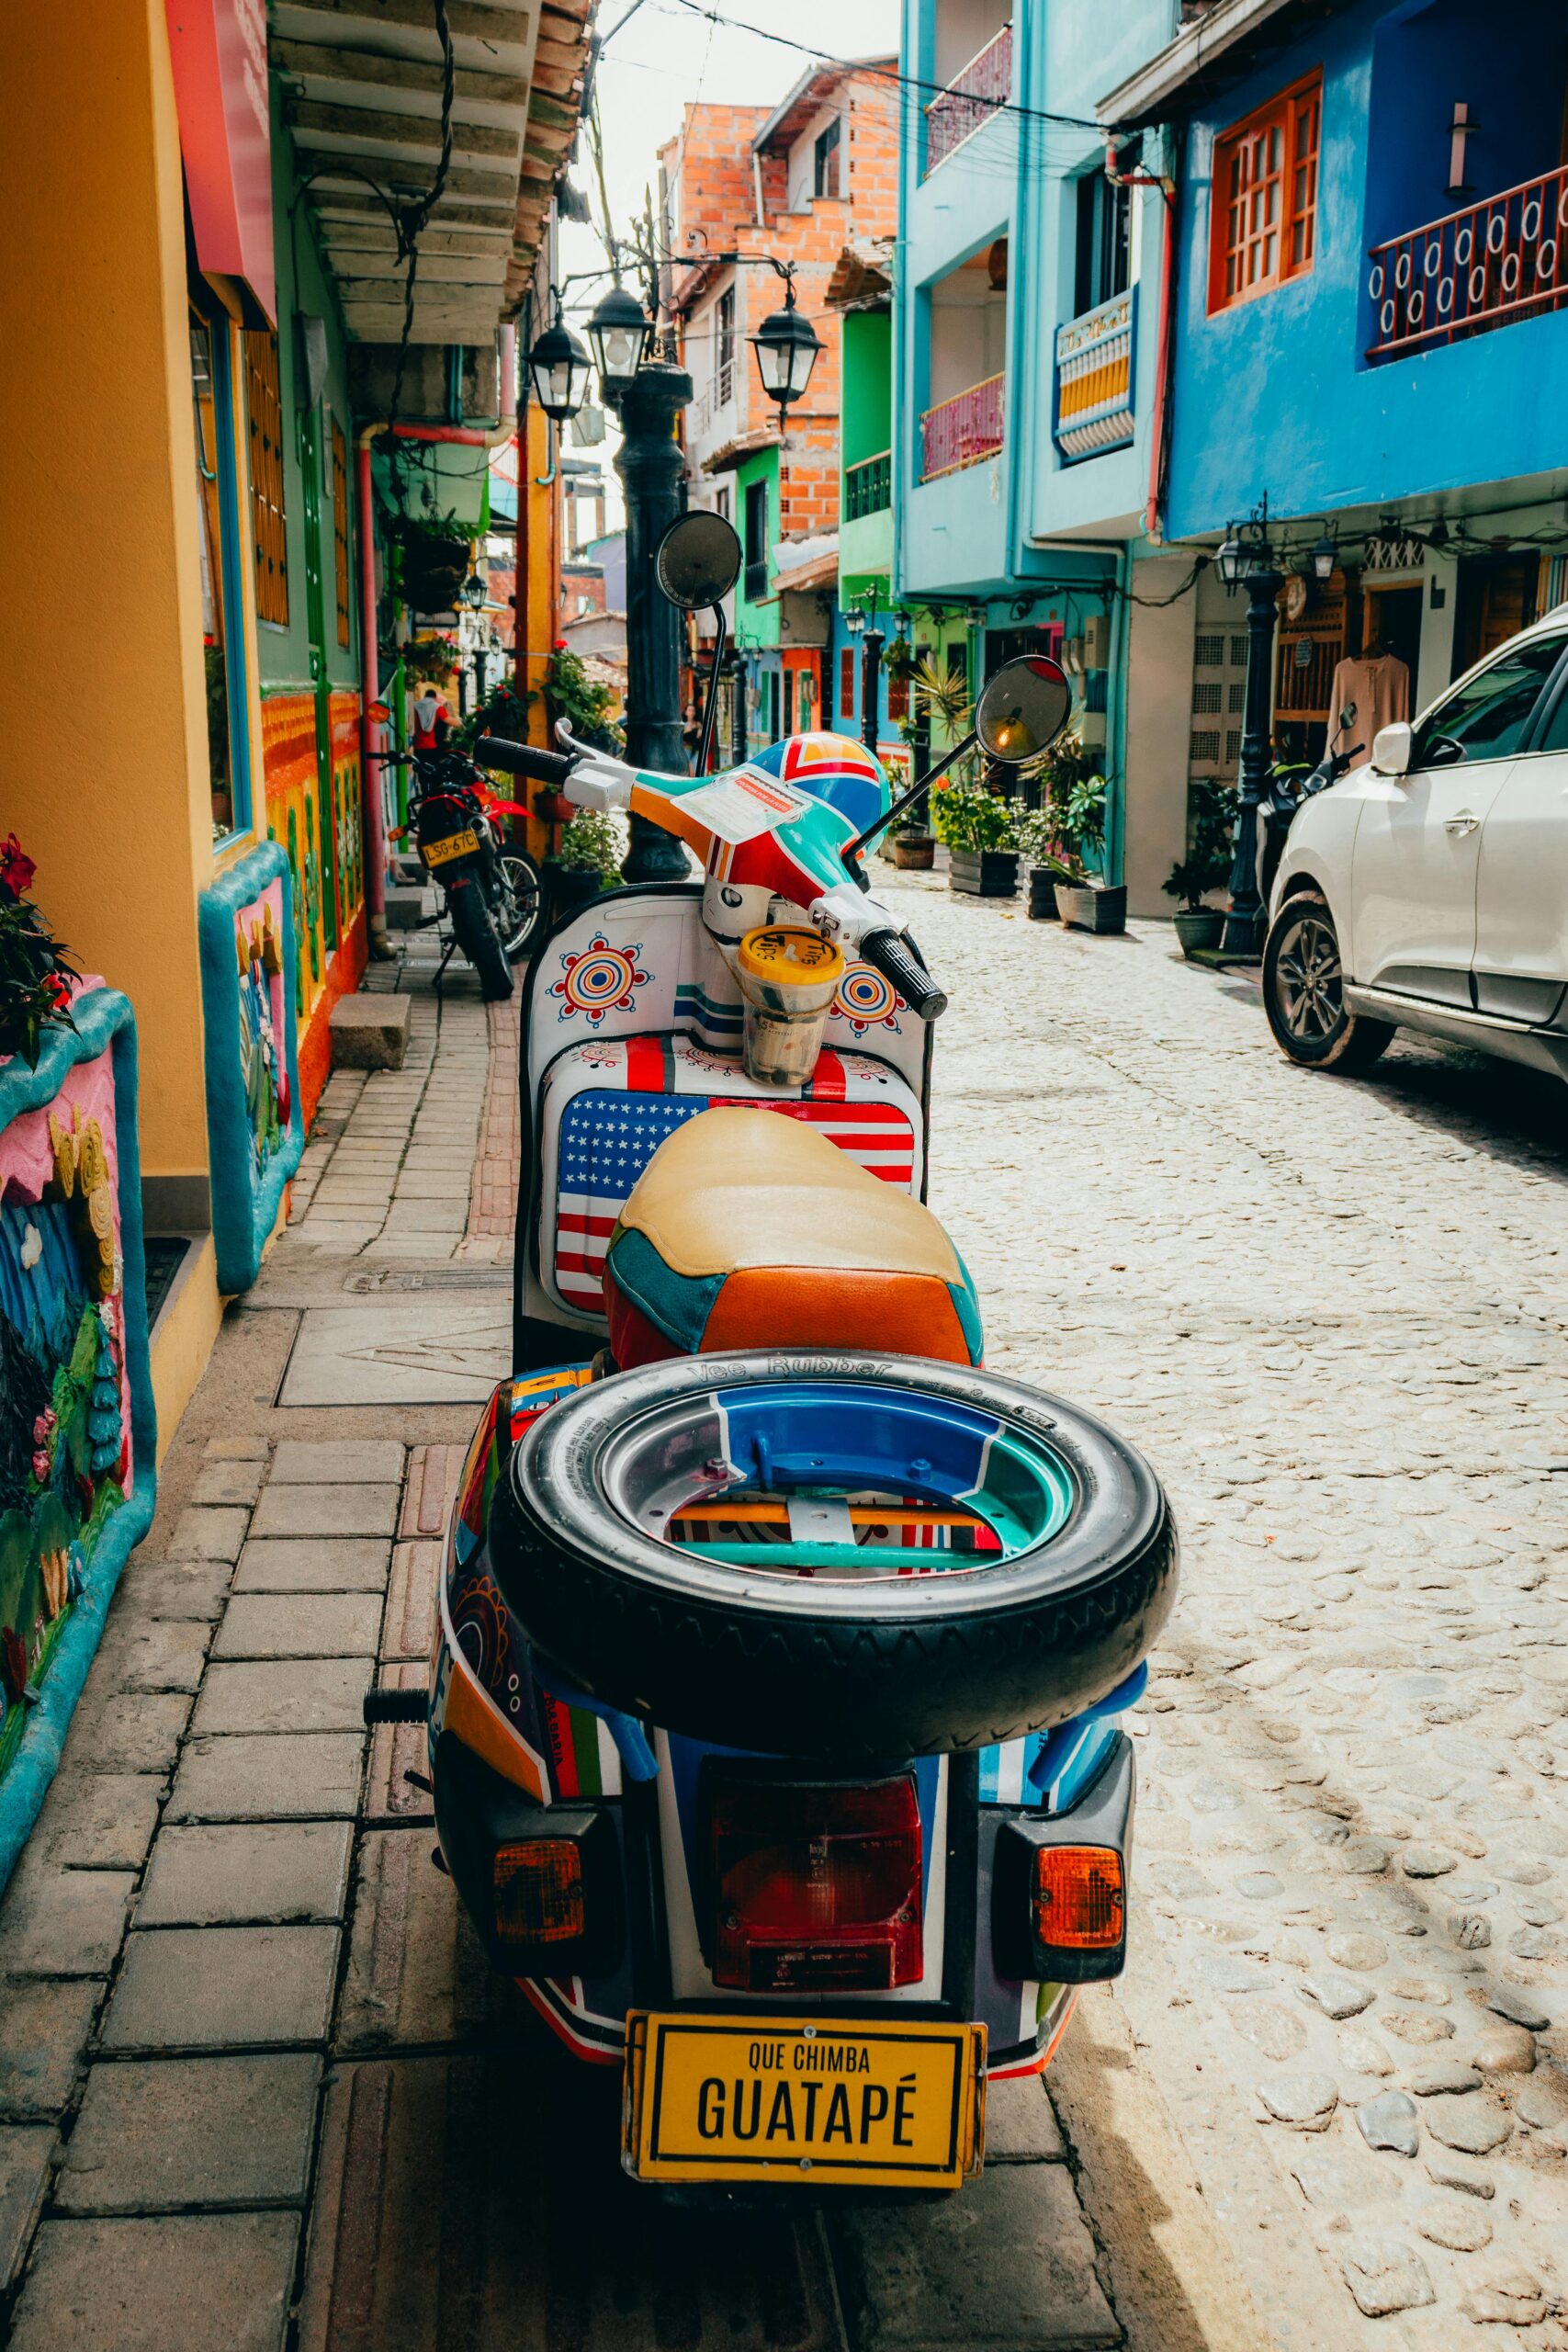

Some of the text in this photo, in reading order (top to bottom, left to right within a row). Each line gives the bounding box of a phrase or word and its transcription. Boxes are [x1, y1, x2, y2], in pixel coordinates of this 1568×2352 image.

[686, 1357, 893, 1383] Vee Rubber
[545, 1696, 564, 1768] BULGARIA
[749, 2042, 870, 2074] QUE CHIMBA
[696, 2073, 918, 2147] GUATAPÉ
